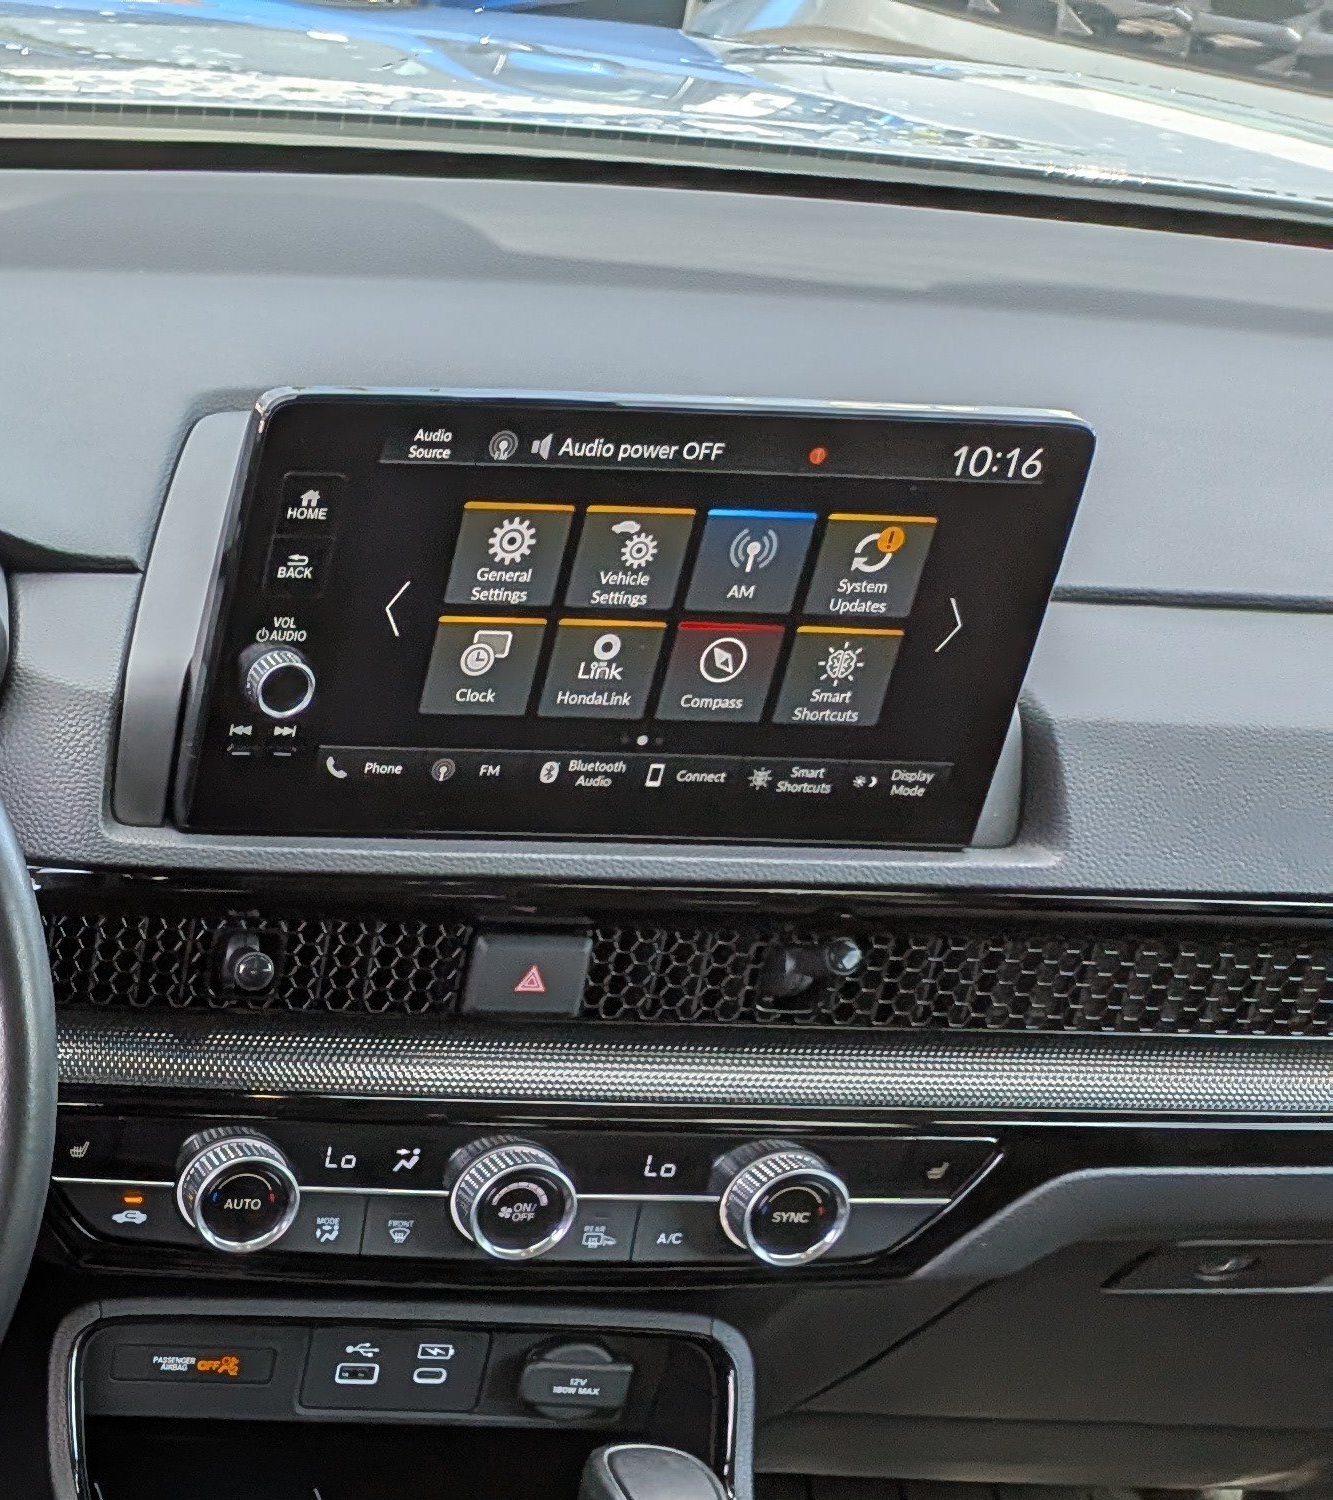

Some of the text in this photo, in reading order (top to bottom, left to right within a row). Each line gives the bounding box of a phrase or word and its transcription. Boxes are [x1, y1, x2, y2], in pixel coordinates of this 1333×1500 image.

[414, 428, 452, 442] Audio
[408, 445, 451, 459] Source
[558, 439, 725, 462] Audio power OFF
[952, 446, 1044, 479] 10:16
[286, 507, 328, 520] HOME
[277, 566, 313, 580] BACK
[476, 568, 533, 583] General
[599, 570, 650, 587] Vehicle
[726, 584, 757, 600] AM
[836, 578, 889, 597] System
[471, 587, 528, 605] Settings
[591, 589, 648, 608] Settings
[829, 598, 887, 616] Updates
[273, 616, 296, 628] VOL
[270, 629, 307, 642] AUDIO
[455, 688, 496, 704] Clock
[556, 690, 632, 708] HondaLink
[680, 694, 743, 711] Compass
[809, 688, 852, 705] Smart
[792, 706, 859, 723] Shortcuts
[364, 760, 403, 778] Phone
[479, 763, 501, 777] FM
[568, 759, 627, 775] Bluetooth
[790, 765, 826, 780] Smart
[574, 773, 613, 788] Audio
[676, 770, 727, 784] Connect
[890, 767, 935, 786] Display
[776, 780, 832, 796] Shortcuts
[890, 784, 926, 798] Mode
[224, 1198, 262, 1211] AUTO
[513, 1202, 538, 1214] ON/
[317, 1217, 341, 1226] MODE
[512, 1212, 535, 1222] OFF
[772, 1211, 812, 1224] SYNC
[388, 1220, 414, 1229] FRONT
[583, 1225, 606, 1233] REAR
[656, 1232, 683, 1245] A/C
[153, 1355, 196, 1365] PASSENGER
[160, 1363, 188, 1371] AIRBAG
[197, 1360, 221, 1371] OFF
